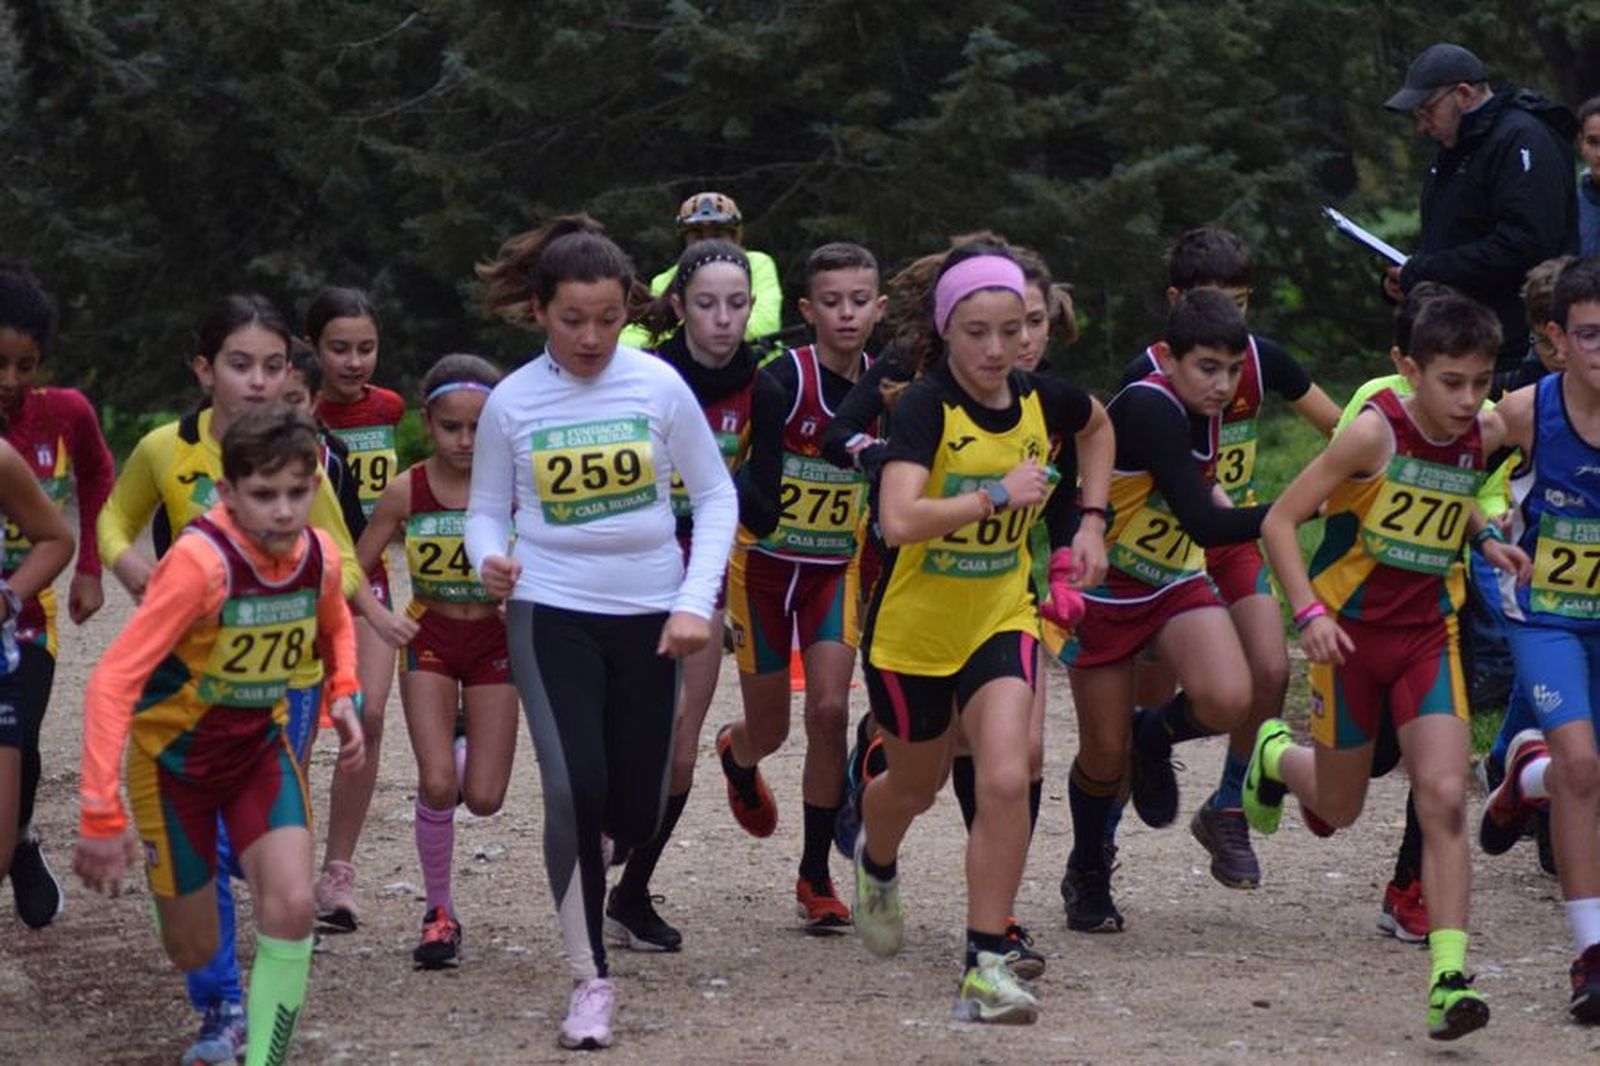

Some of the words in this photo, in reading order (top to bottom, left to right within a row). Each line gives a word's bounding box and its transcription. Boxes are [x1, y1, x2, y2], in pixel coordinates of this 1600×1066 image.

[546, 448, 642, 495] 259
[780, 483, 853, 525] 275
[1379, 490, 1463, 541] 270
[222, 627, 305, 674] 278
